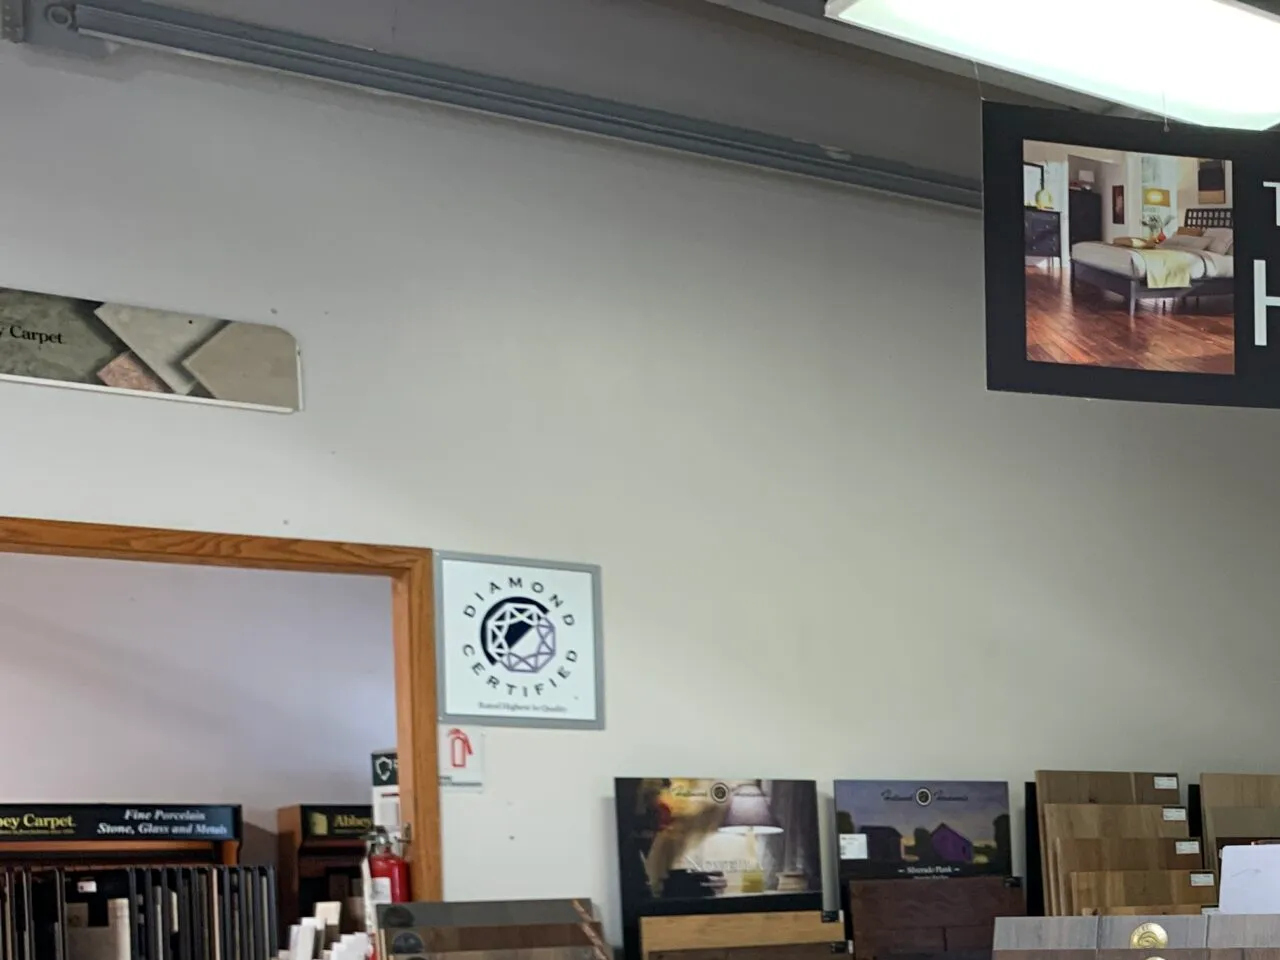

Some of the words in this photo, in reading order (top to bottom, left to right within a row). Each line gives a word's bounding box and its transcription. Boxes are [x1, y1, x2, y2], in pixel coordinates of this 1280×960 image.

[9, 324, 65, 345] Carpet
[463, 577, 576, 627] DIAMOND
[462, 644, 578, 697] CERTIFIED
[23, 813, 74, 829] Carpet
[124, 809, 152, 820] Fine
[154, 809, 206, 820] Porcelain
[97, 822, 135, 835] Stone,
[138, 822, 169, 834] Glass
[171, 823, 193, 834] and
[195, 823, 228, 835] Metals
